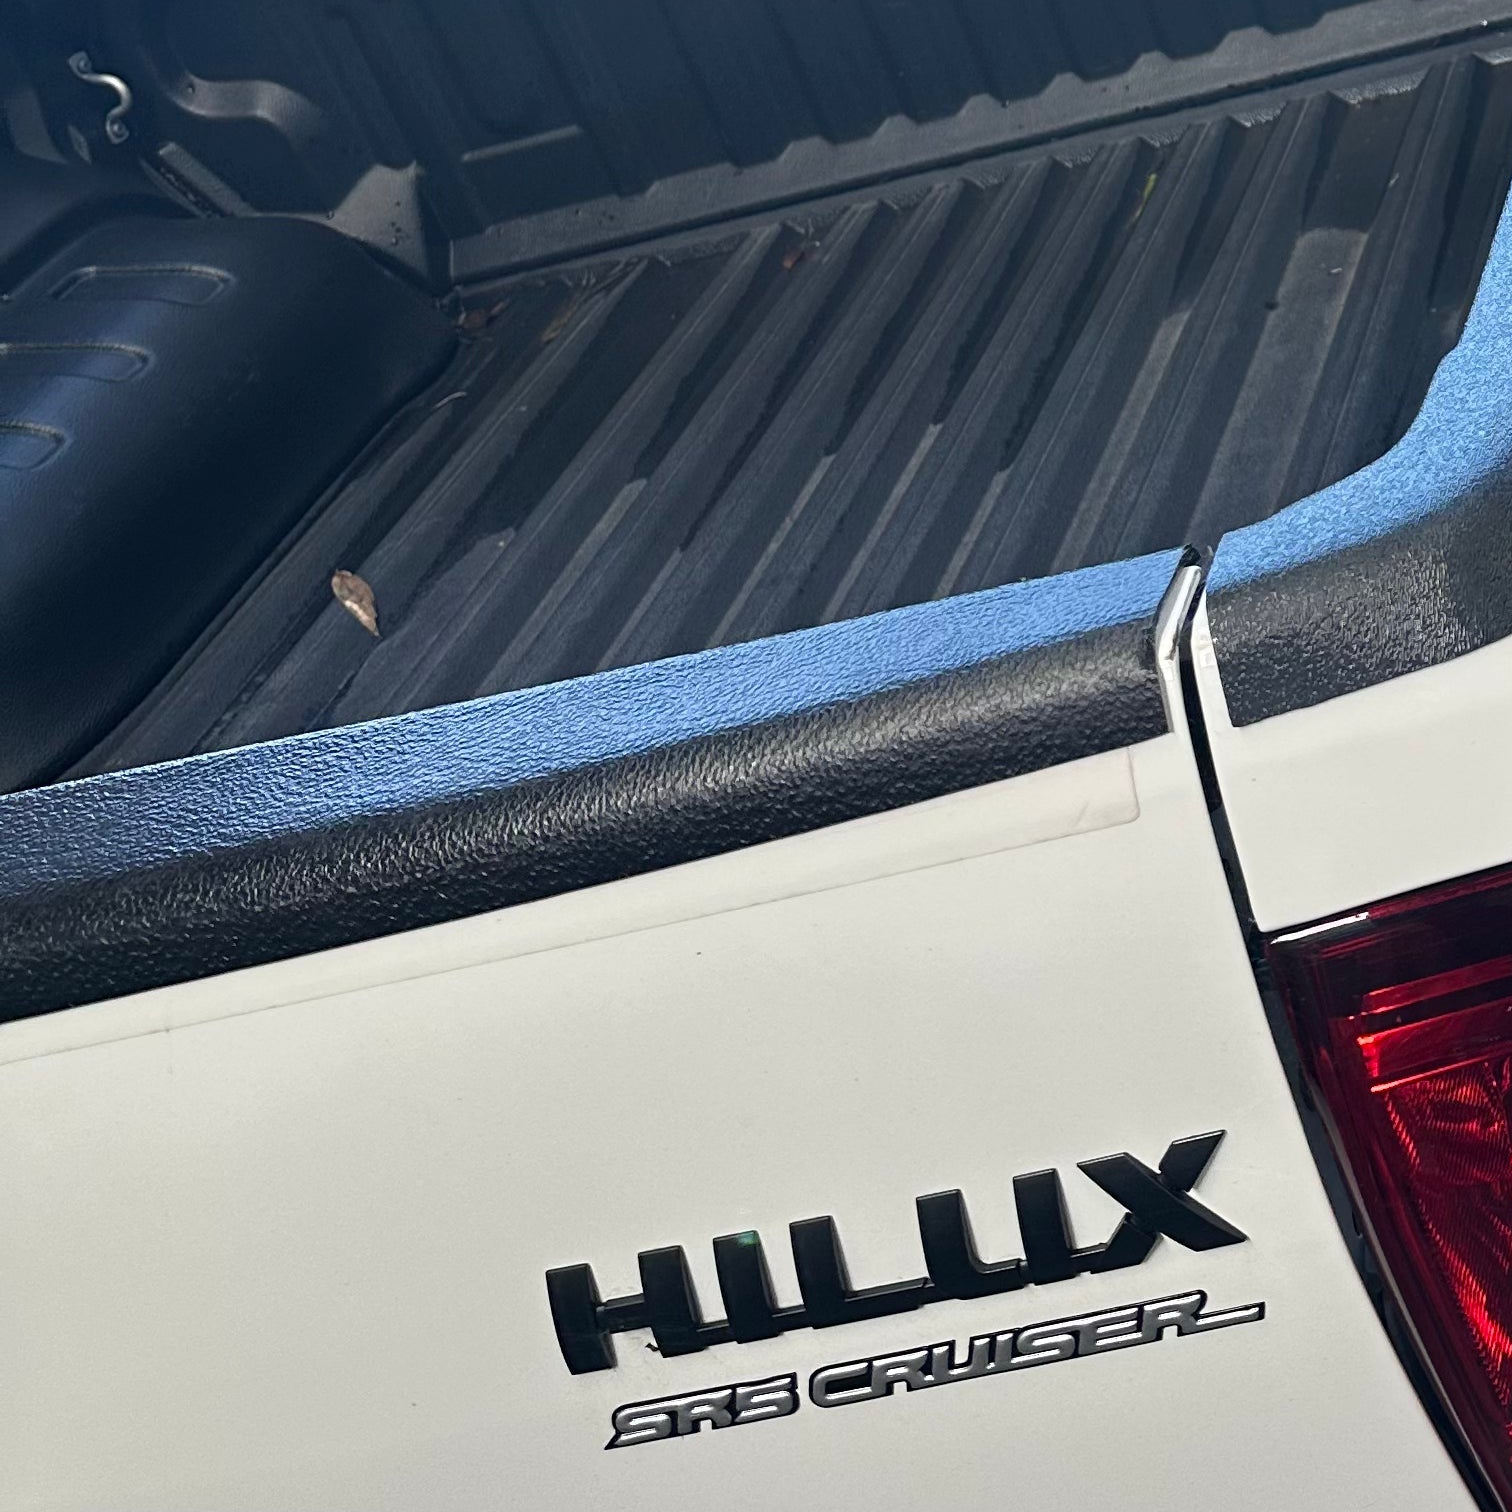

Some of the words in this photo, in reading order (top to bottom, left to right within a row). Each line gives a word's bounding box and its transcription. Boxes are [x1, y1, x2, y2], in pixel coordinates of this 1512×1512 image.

[546, 1129, 1248, 1375] HILUX
[604, 1372, 800, 1450] SR5
[809, 1289, 1265, 1407] CRUISER
